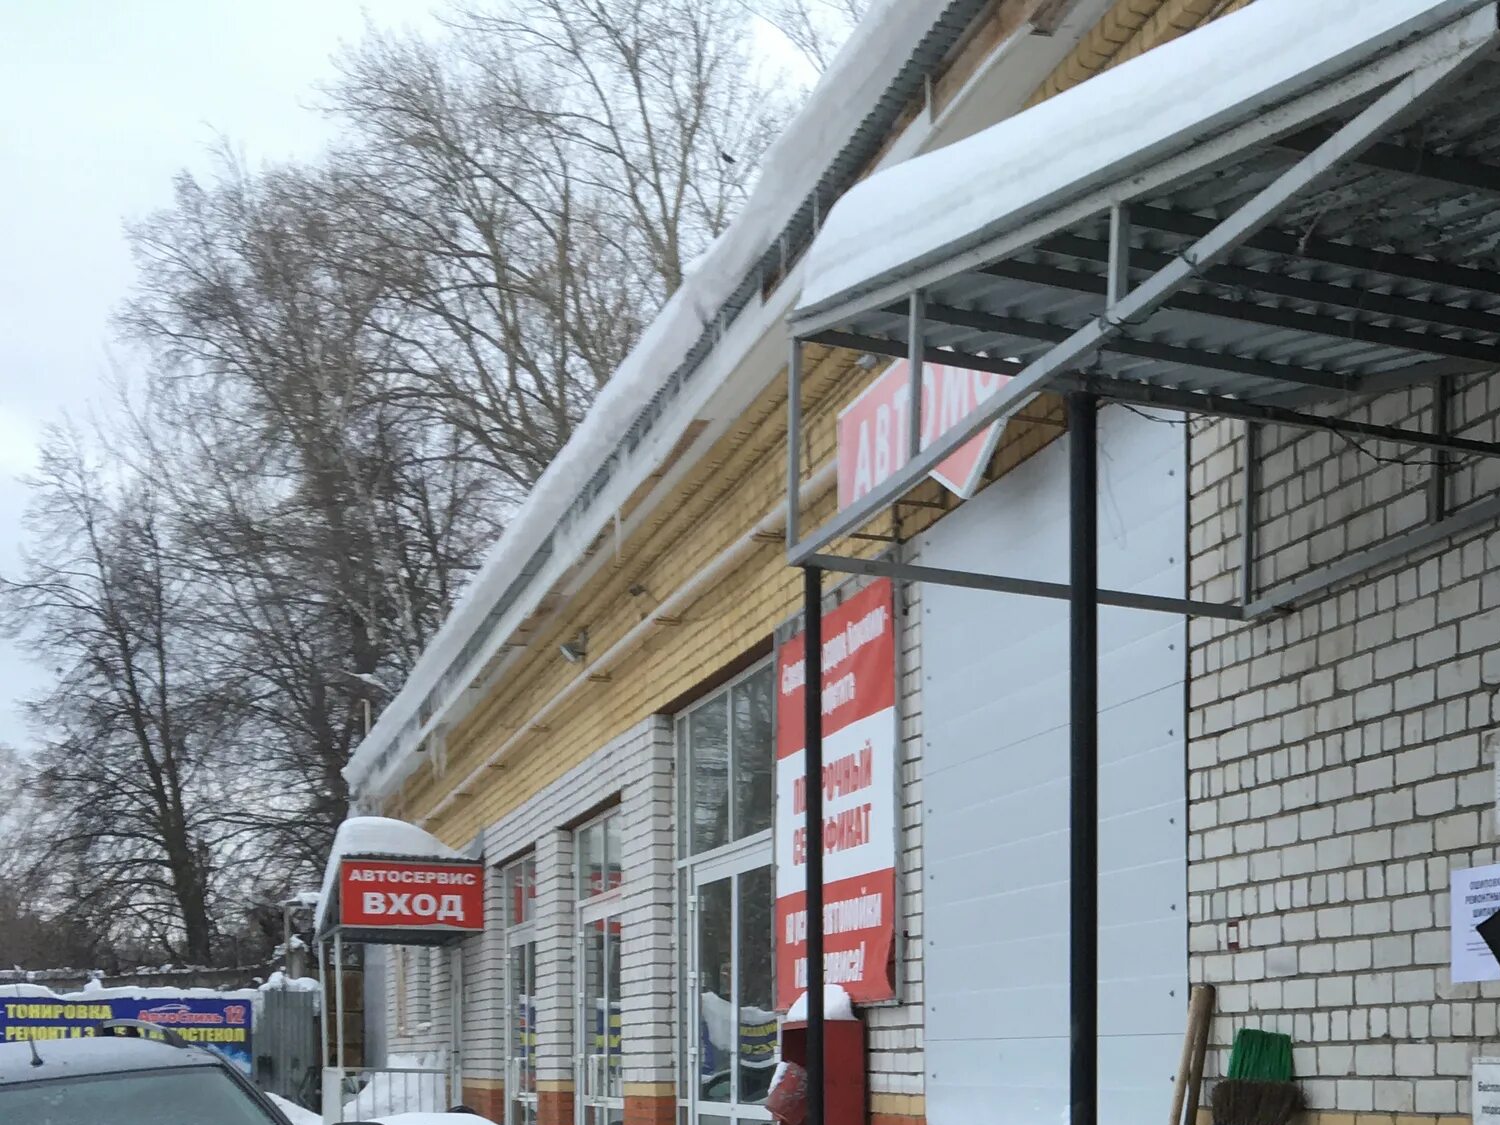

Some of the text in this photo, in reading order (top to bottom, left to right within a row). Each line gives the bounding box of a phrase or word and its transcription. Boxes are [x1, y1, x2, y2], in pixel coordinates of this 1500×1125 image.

[349, 869, 477, 885] АВТОСЕРВИС
[363, 891, 464, 921] ВХОД
[4, 1004, 113, 1020] ТОНИРОВКА
[224, 1005, 245, 1024] 12
[5, 1026, 69, 1041] РЕМОНТ
[71, 1026, 82, 1039] И
